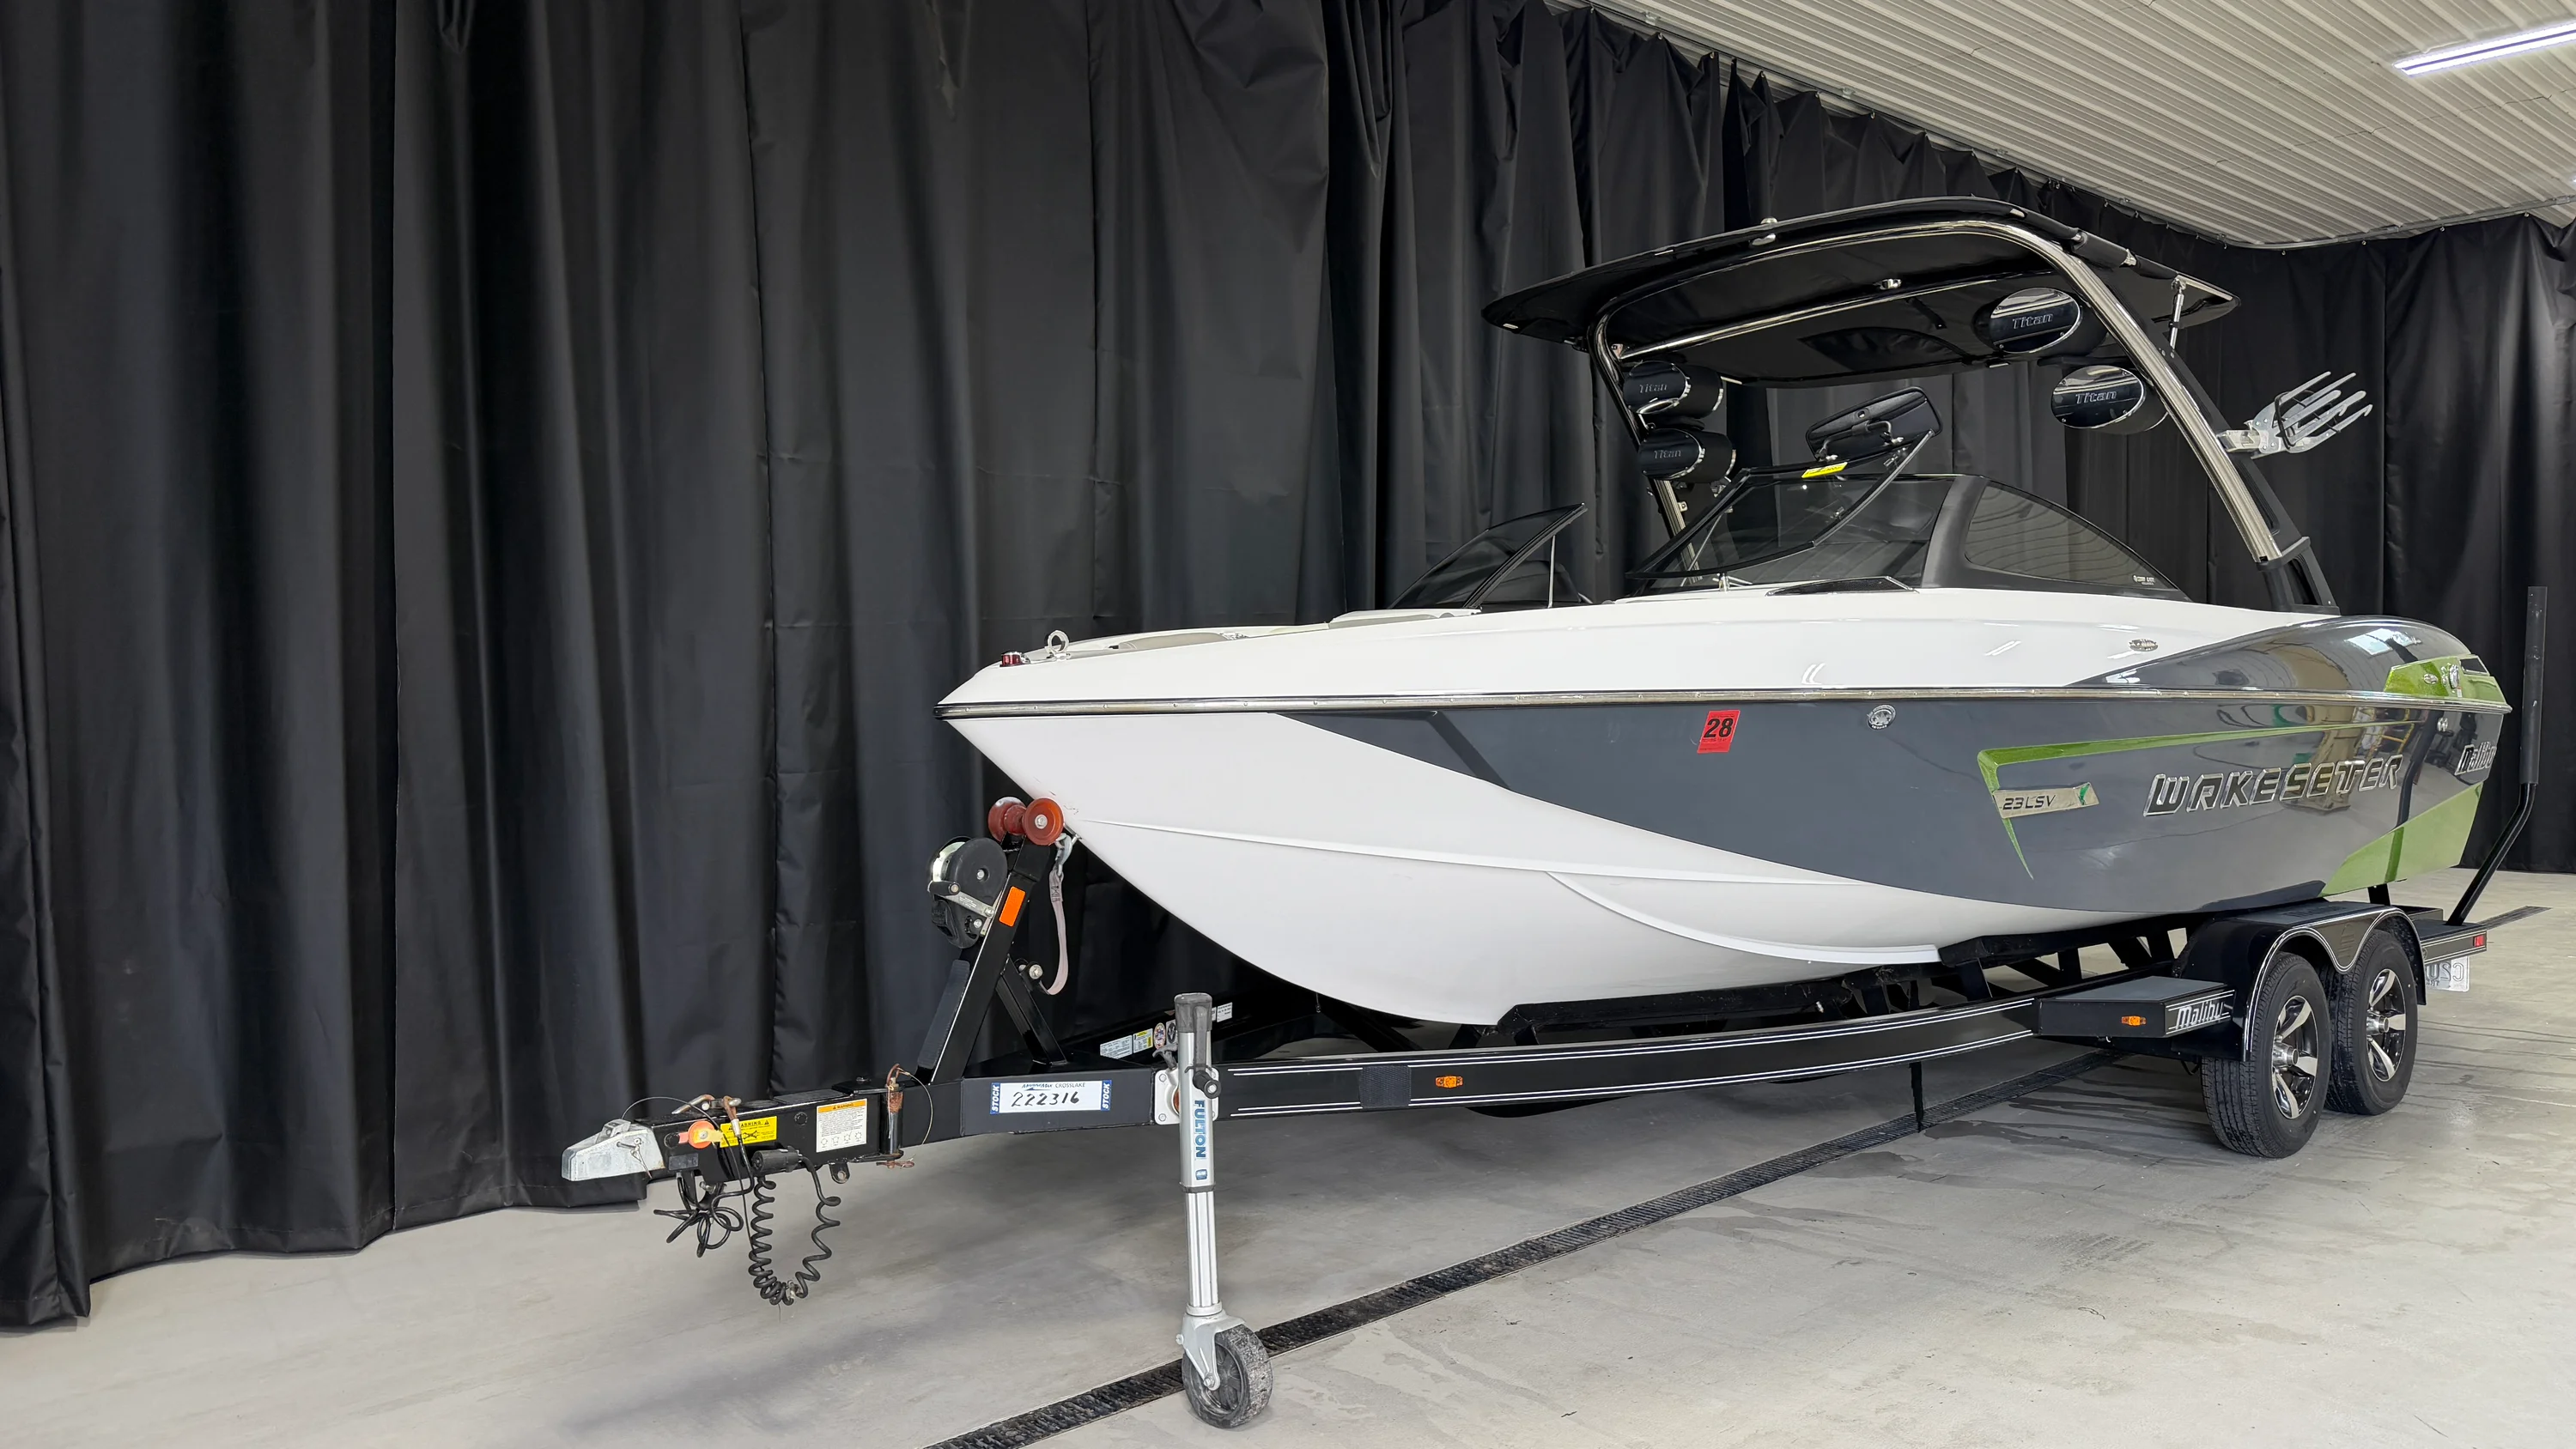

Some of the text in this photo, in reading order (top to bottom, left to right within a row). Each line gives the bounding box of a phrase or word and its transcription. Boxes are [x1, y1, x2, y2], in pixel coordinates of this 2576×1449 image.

[2012, 312, 2054, 330] Titan
[1639, 383, 1668, 394] Titan
[2075, 390, 2117, 404] Titan
[1654, 449, 1681, 459] Titan
[1703, 717, 1734, 738] 28
[2142, 754, 2403, 817] WAKESETTER
[2002, 794, 2057, 810] 23LSV
[2175, 999, 2225, 1030] Malibu
[992, 1084, 1000, 1113] STOCK
[1011, 1091, 1080, 1107] 222316
[1194, 1100, 1206, 1158] FULTON
